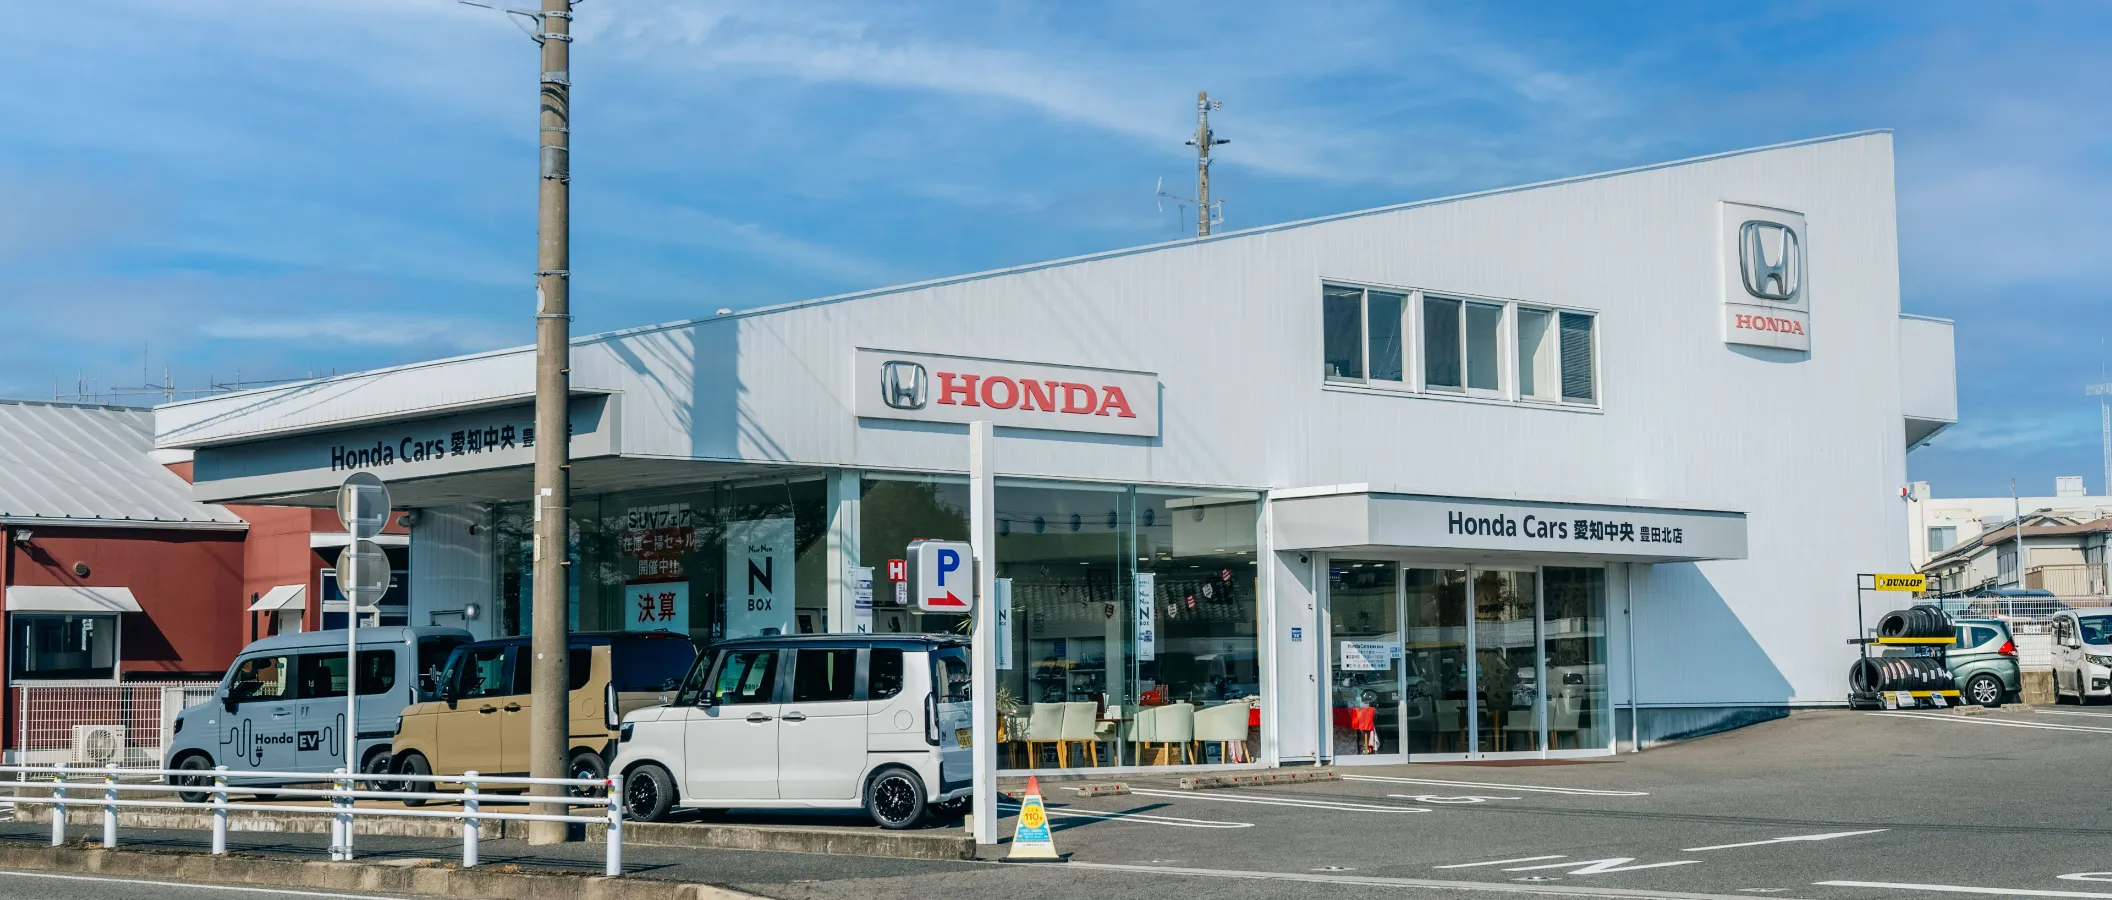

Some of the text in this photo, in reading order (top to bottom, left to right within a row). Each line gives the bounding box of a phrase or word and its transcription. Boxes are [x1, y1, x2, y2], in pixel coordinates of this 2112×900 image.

[1735, 314, 1804, 336] HONDA
[936, 371, 1136, 418] HONDA
[331, 441, 394, 471] Honda
[400, 436, 444, 463] Cars
[451, 424, 516, 457] 愛知中央
[1448, 510, 1683, 544] Honda Cars 愛知中央 豊田北店
[748, 556, 772, 595] N
[889, 562, 904, 580] H
[937, 549, 960, 587] P
[1886, 578, 1922, 587] DUNLOP
[638, 592, 676, 622] 決算
[748, 598, 772, 611] BOX
[1139, 607, 1149, 620] N
[255, 732, 317, 748] Honda EV
